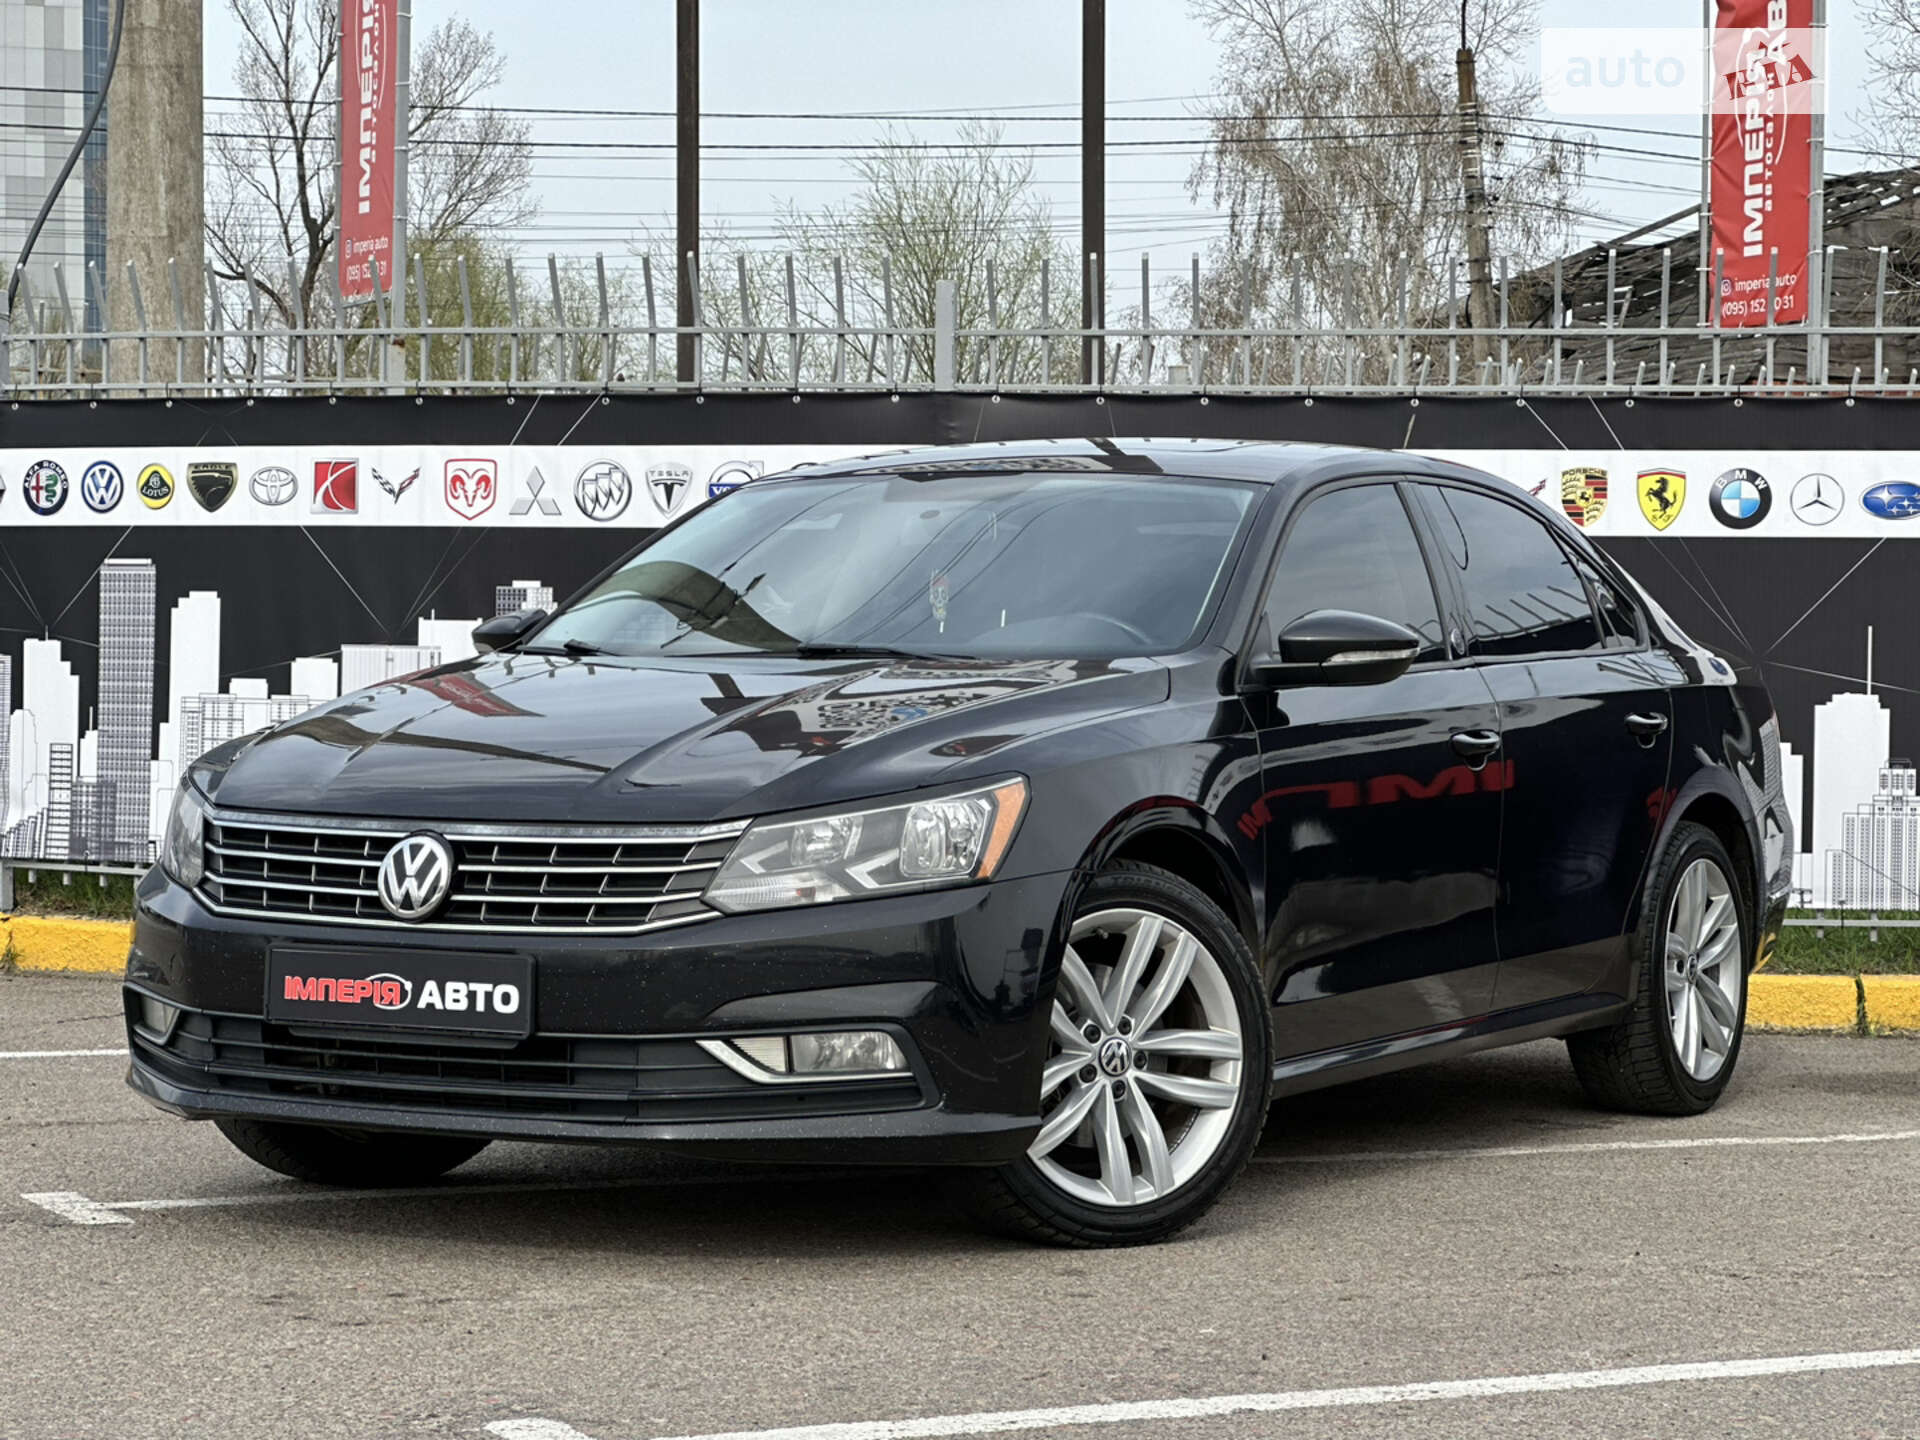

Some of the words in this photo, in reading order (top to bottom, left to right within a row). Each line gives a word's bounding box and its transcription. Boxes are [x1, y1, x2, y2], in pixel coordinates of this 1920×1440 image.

[1722, 300, 1747, 319] (095)
[1750, 298, 1766, 313] 152
[1783, 294, 1794, 309] 31
[24, 463, 40, 488] ALFA
[43, 460, 68, 489] ROMEO
[1715, 469, 1768, 490] BMW
[142, 486, 170, 497] LOTUS
[417, 980, 520, 1014] АВТО
